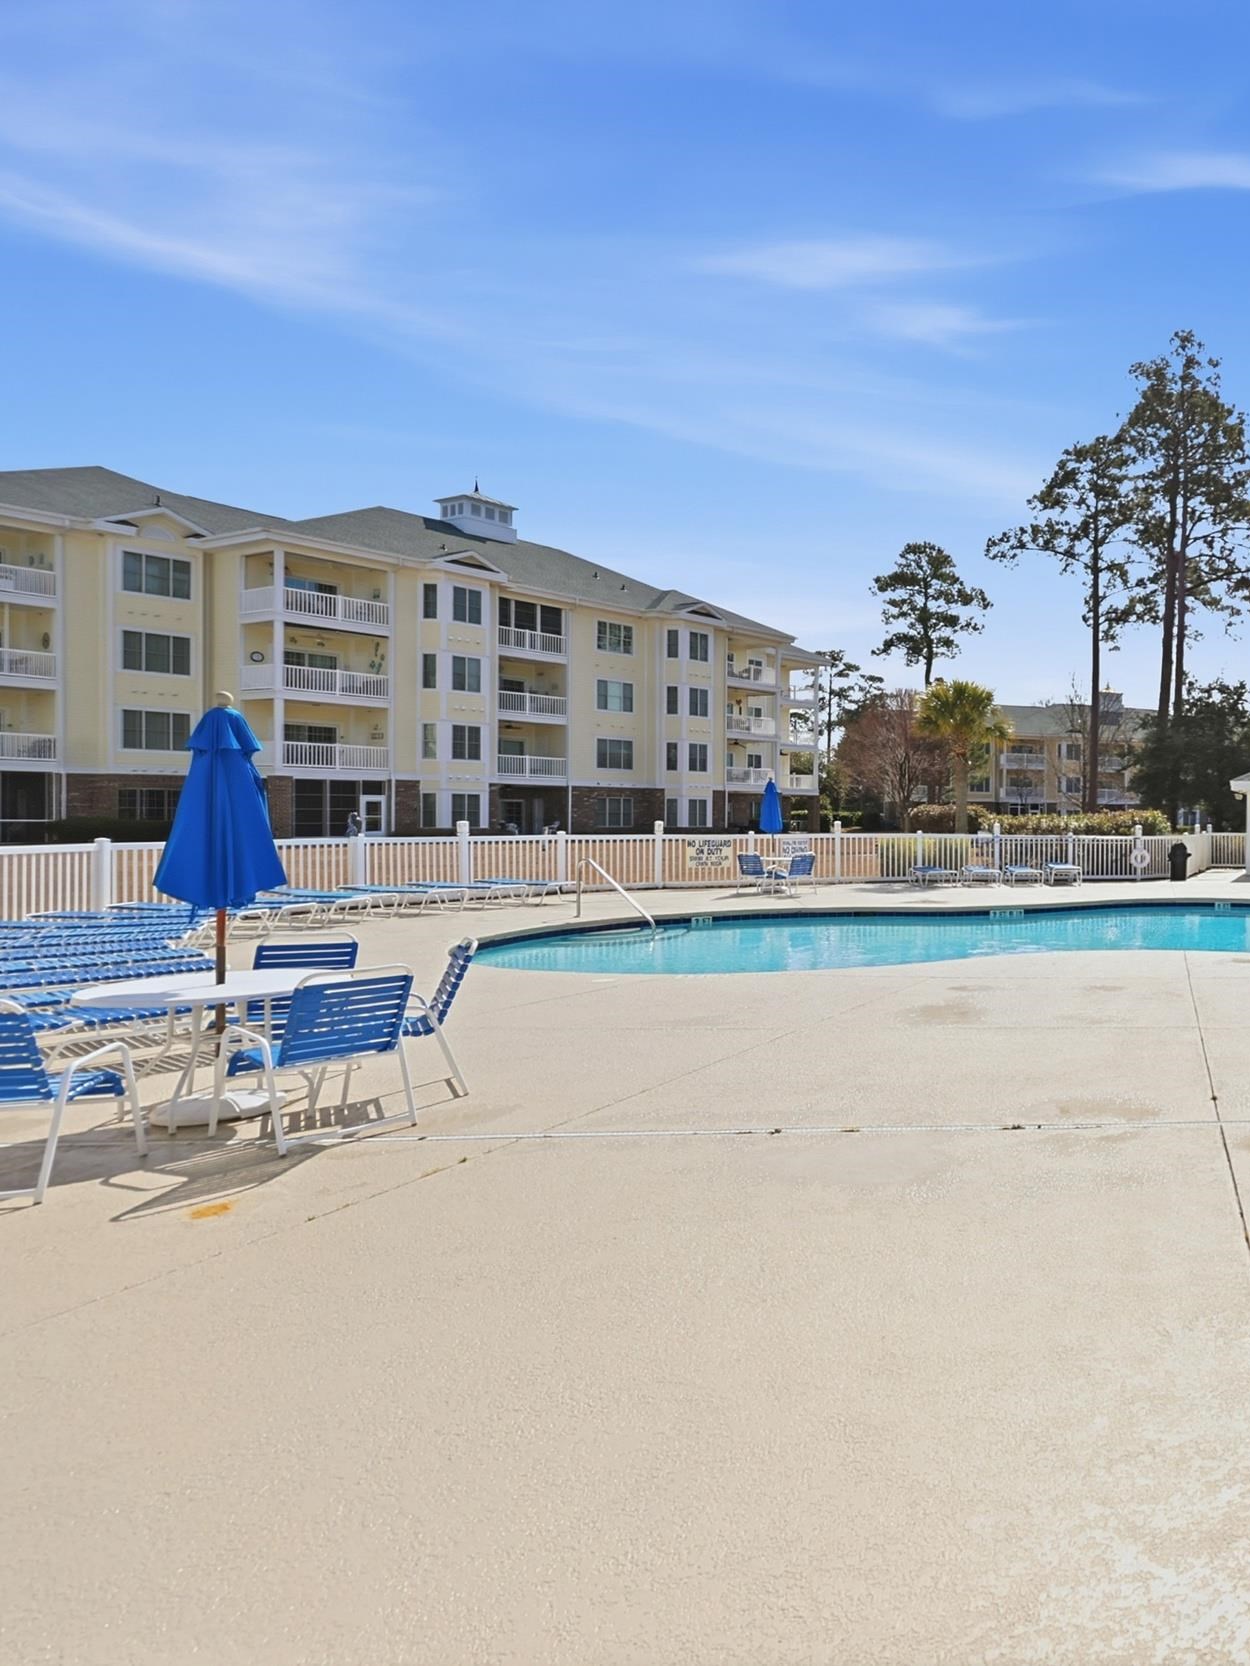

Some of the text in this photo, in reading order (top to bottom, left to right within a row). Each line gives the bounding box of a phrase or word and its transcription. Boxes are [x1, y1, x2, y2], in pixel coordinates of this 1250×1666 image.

[687, 839, 731, 848] NO LIFEGUARD
[707, 848, 722, 856] DUTY
